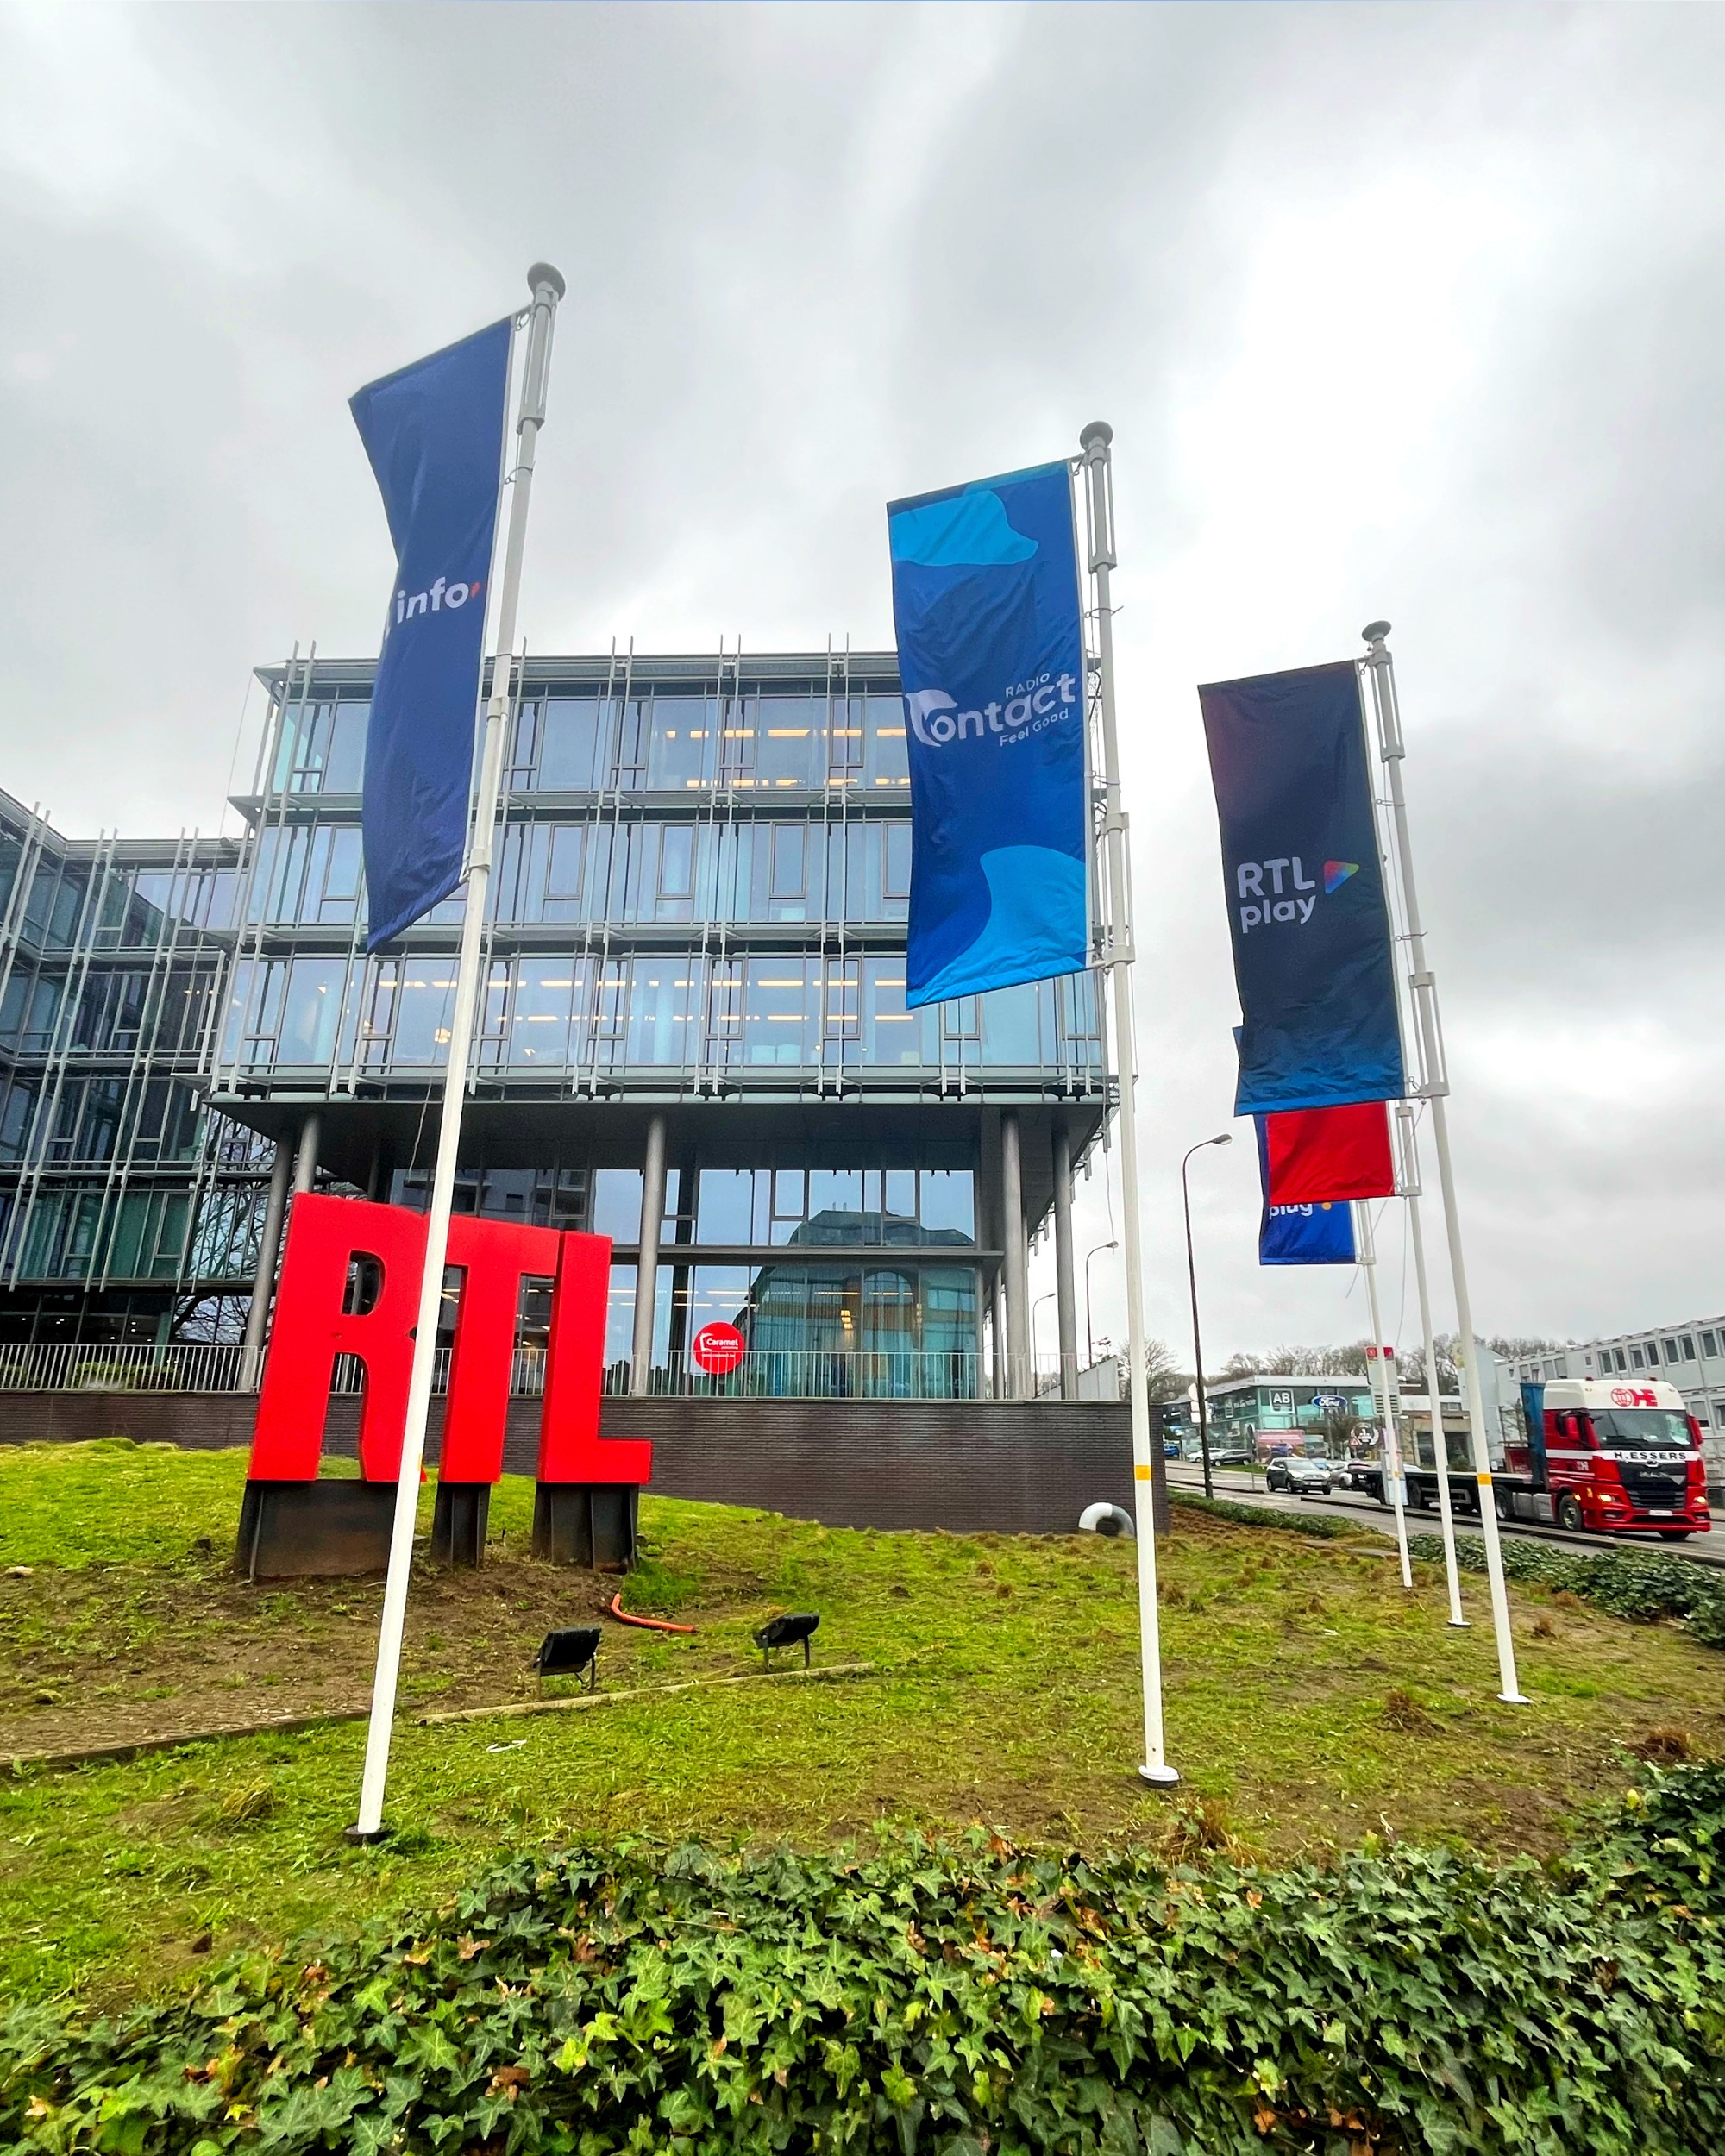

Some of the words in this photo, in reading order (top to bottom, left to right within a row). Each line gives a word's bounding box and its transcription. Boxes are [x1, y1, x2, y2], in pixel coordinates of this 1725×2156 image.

[1006, 673, 1051, 698] RADIO
[1000, 727, 1030, 747] Feel
[1032, 708, 1070, 732] Good
[1236, 856, 1316, 899] RTL
[1240, 895, 1317, 934] play
[248, 1191, 653, 1483] RTL
[1273, 1392, 1290, 1404] AB
[1318, 1396, 1341, 1407] Ford
